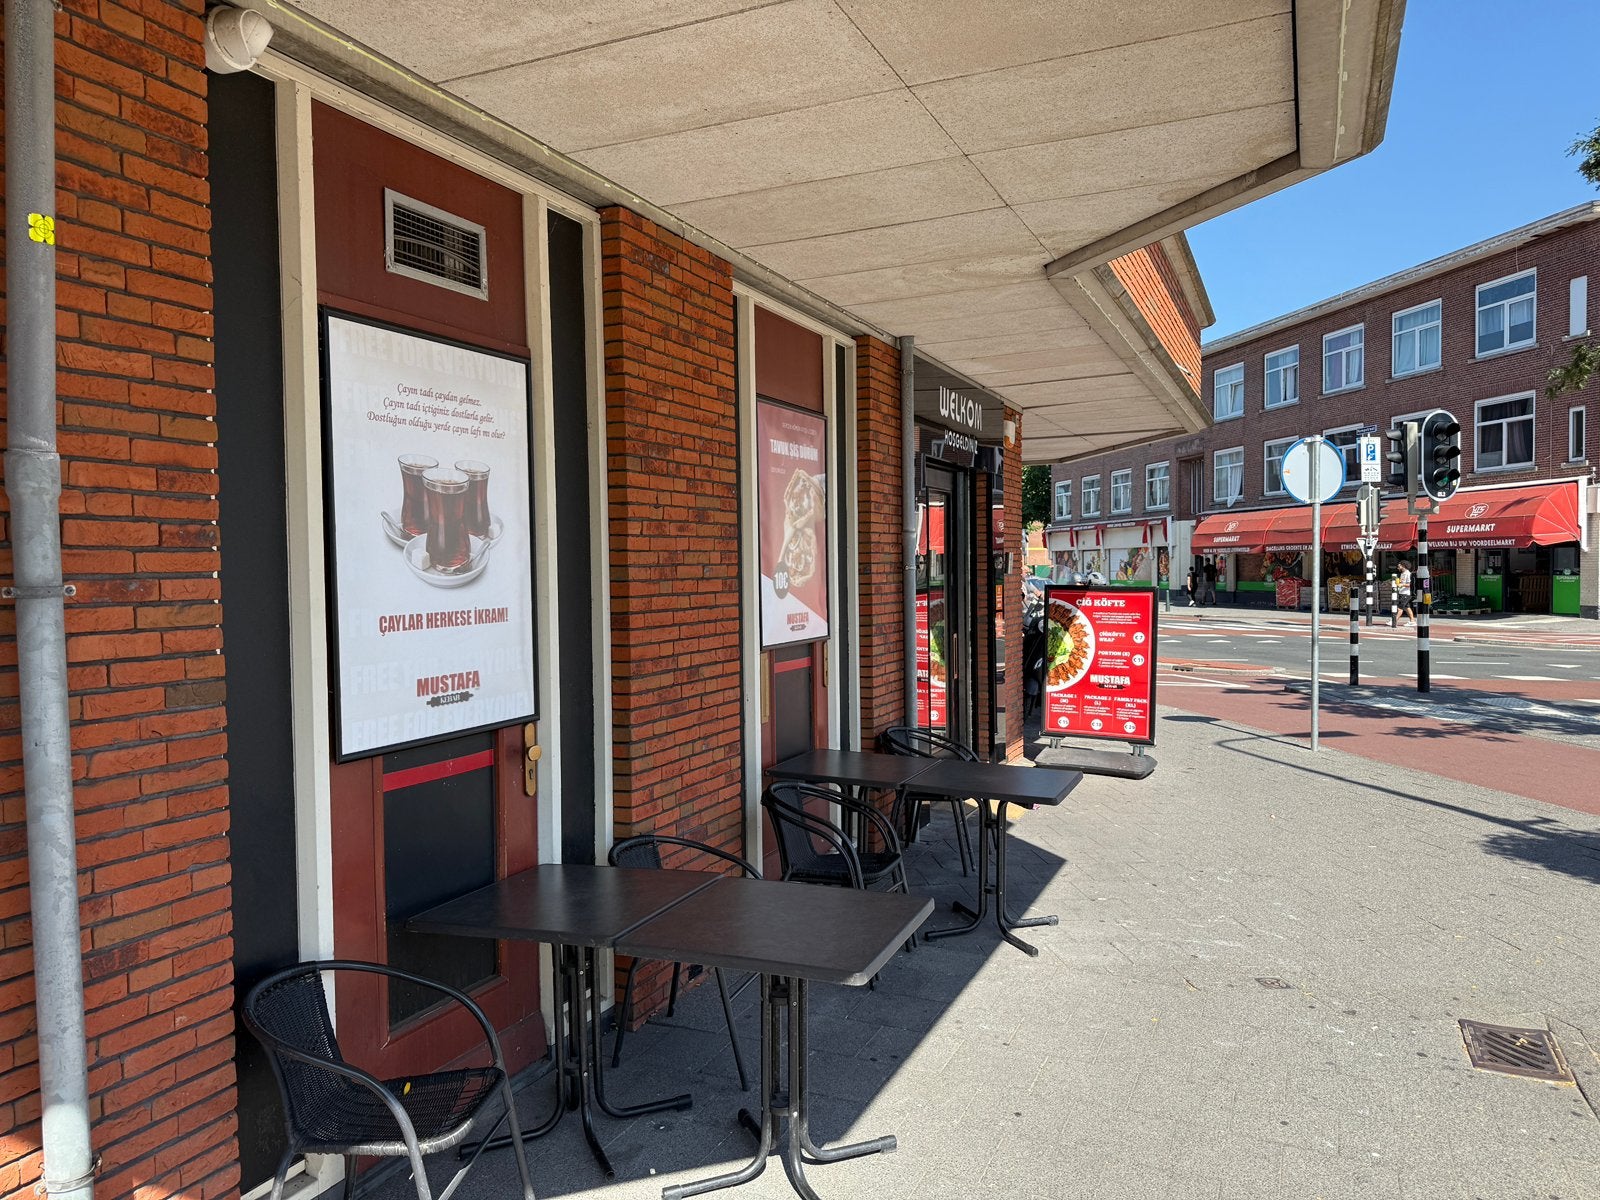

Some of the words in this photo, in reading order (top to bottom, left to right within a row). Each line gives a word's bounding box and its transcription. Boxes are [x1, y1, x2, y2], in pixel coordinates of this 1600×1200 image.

[397, 383, 418, 396] Çayın
[419, 387, 434, 398] tadı
[434, 390, 458, 402] çaydan
[383, 397, 404, 410] Çayın
[406, 400, 421, 411] tadı
[939, 386, 983, 431] WELKOM
[367, 411, 407, 427] Dostluğun
[408, 416, 432, 431] olduğu
[433, 421, 451, 432] yerde
[452, 425, 469, 436] çayın
[1446, 523, 1496, 533] SUPERMARKT
[1213, 535, 1240, 543] SUPERMARKT
[1093, 598, 1126, 607] KÖFTE
[379, 613, 424, 637] ÇAYLAR
[426, 609, 472, 630] HERKESE
[474, 606, 509, 625] İKRAM!
[416, 670, 481, 698] MUSTAFA
[1090, 674, 1131, 685] MUSTAFA
